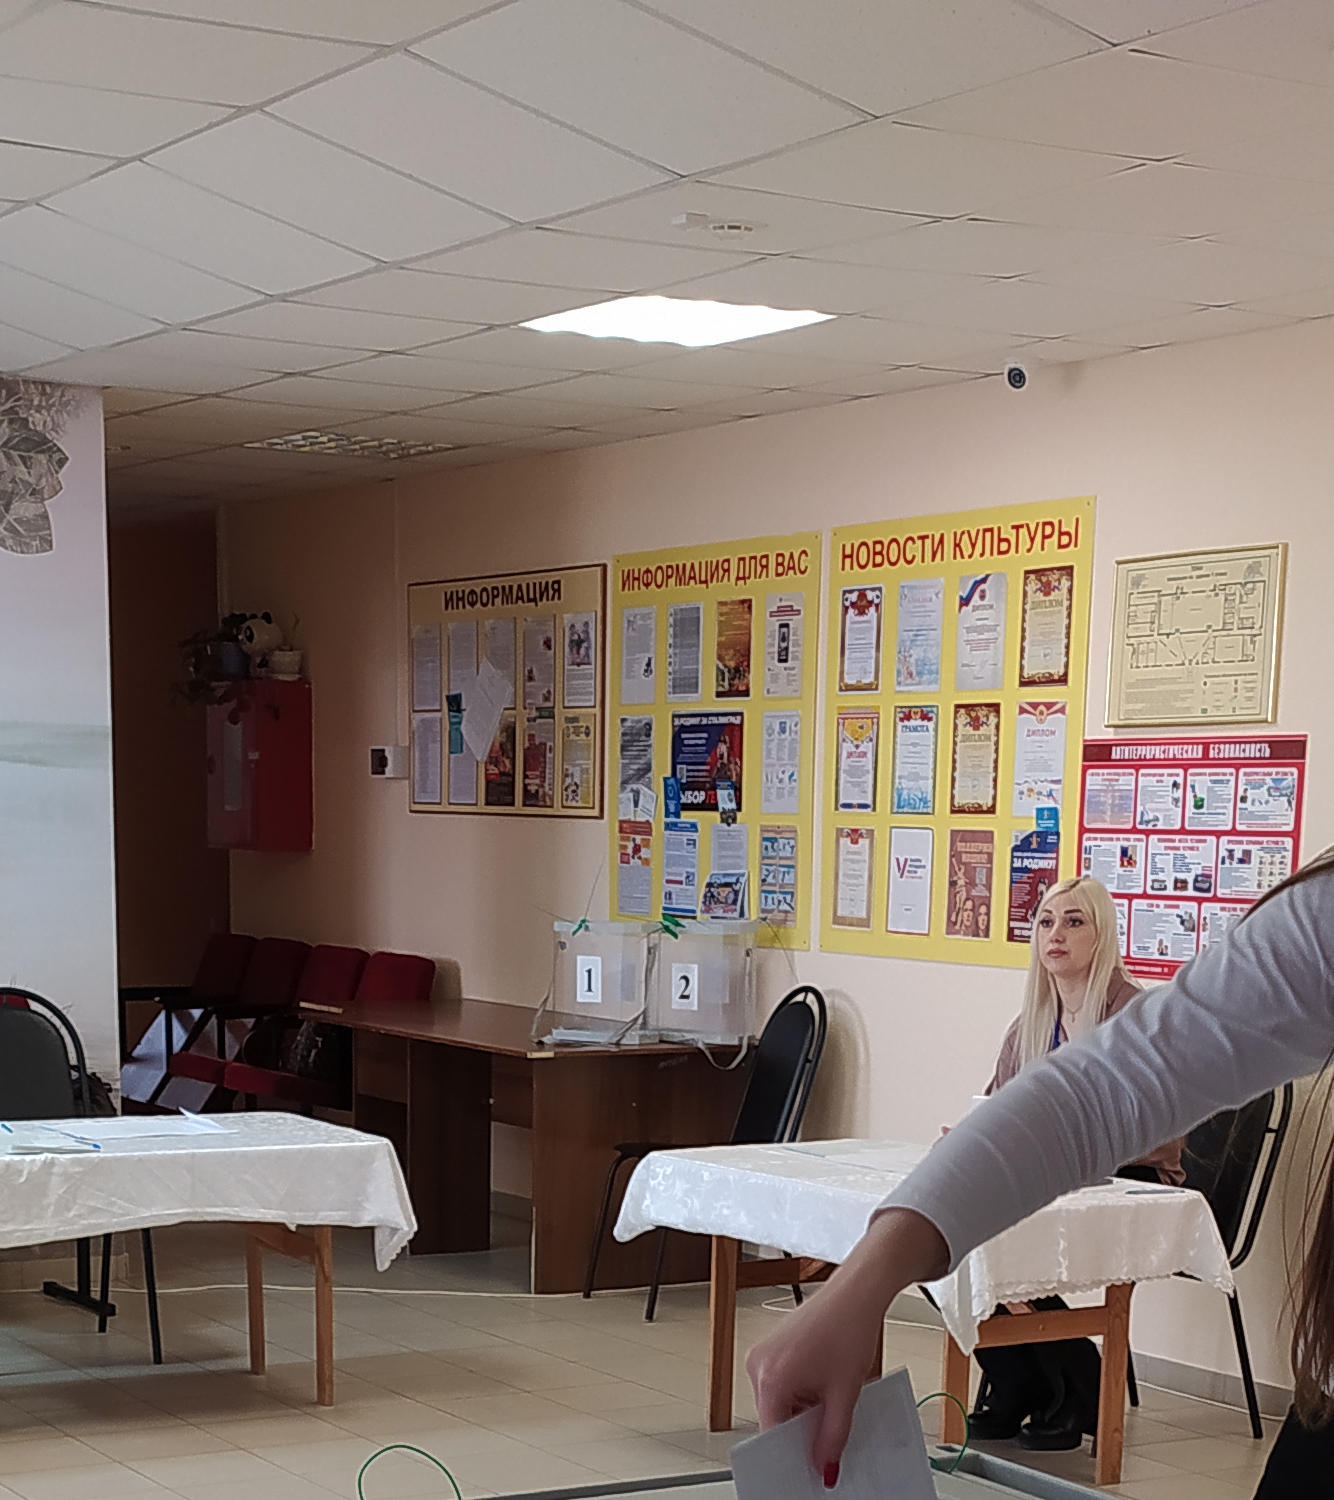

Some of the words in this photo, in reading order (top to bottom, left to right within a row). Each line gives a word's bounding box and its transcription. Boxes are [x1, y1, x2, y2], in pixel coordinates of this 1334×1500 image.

[841, 532, 945, 571] НОВОСТИ
[952, 517, 1080, 560] КУЛЬТУРЫ
[621, 558, 731, 592] ИНФОРМАЦИЯ
[735, 554, 769, 586] ДЛЯ
[775, 549, 809, 578] ВАС
[444, 579, 562, 611] ИНФОРМАЦИЯ
[1026, 728, 1057, 738] ДИПЛОМ
[584, 967, 594, 993] 1
[677, 974, 691, 1000] 2
